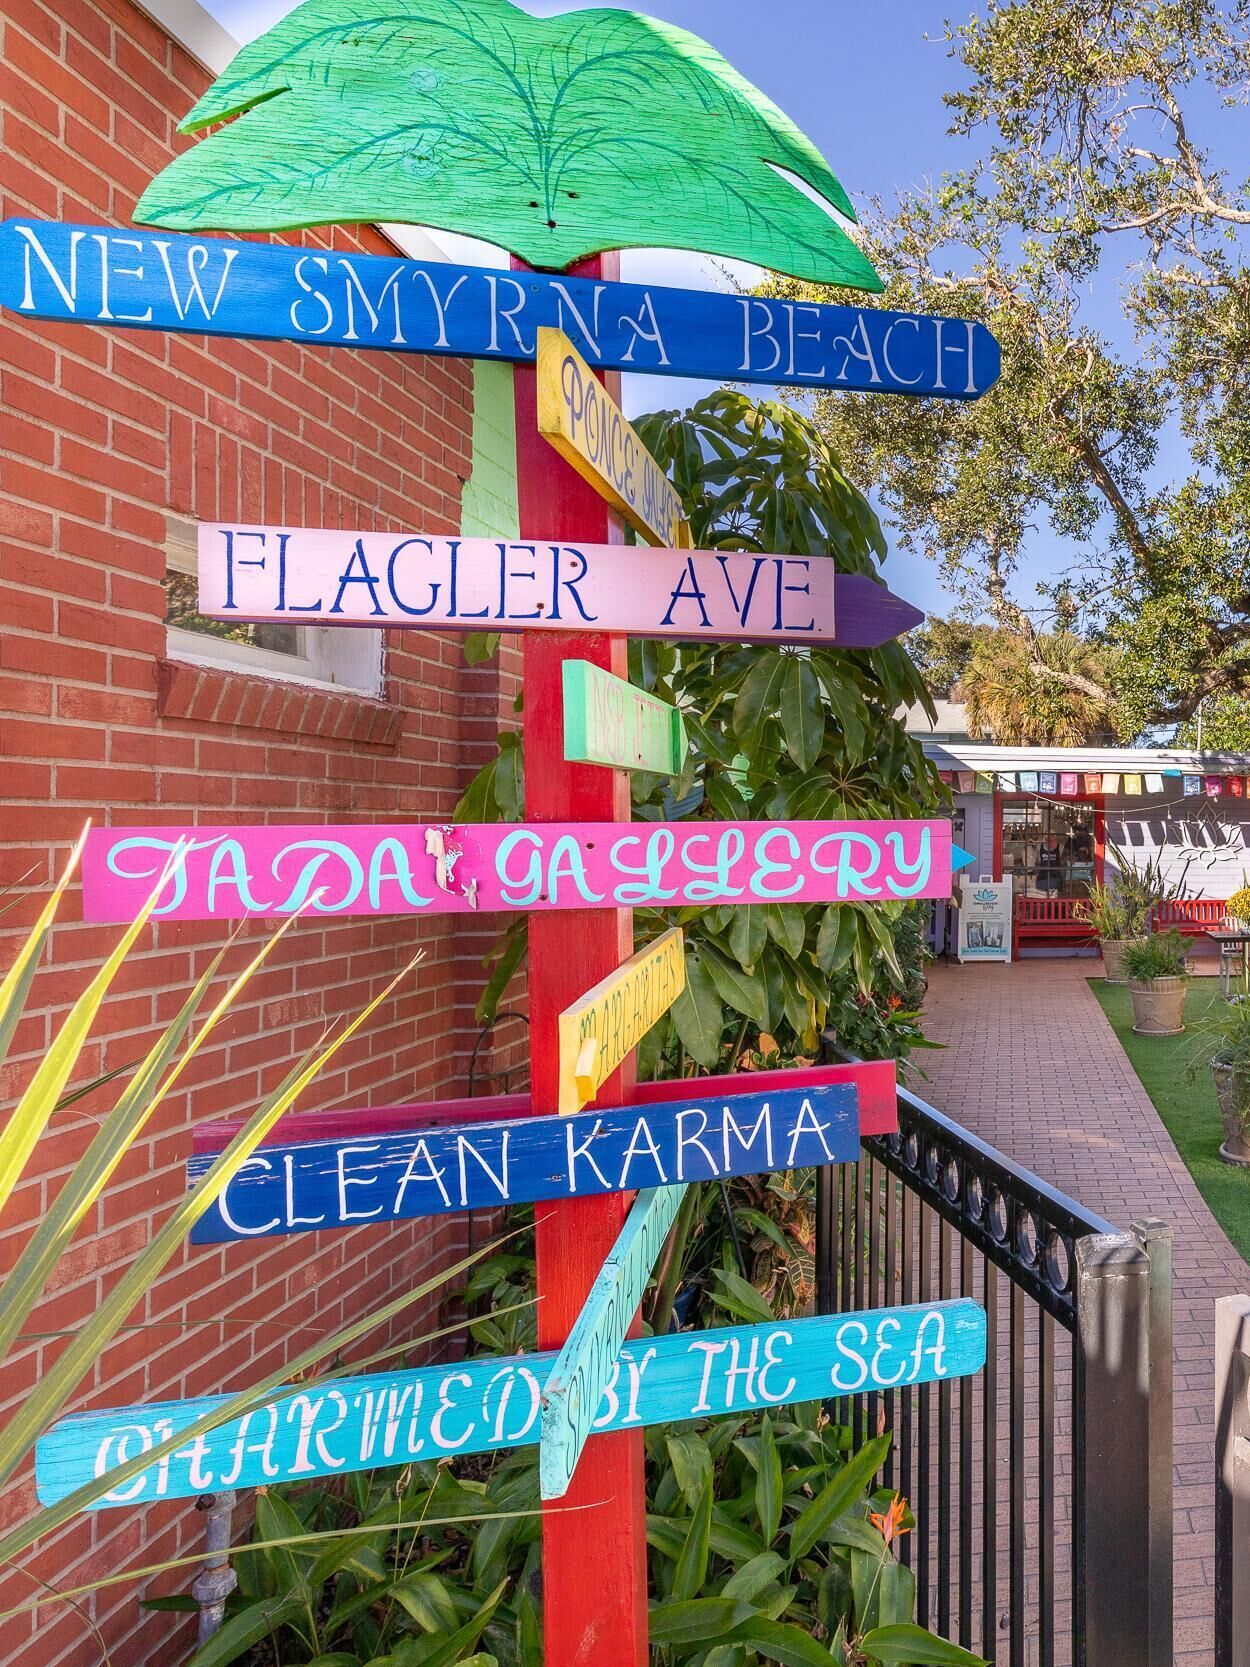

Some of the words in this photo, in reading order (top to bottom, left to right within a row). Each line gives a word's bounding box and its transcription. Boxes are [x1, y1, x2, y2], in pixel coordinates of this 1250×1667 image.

[14, 225, 240, 322] NEW
[290, 255, 673, 366] SMYRNA
[738, 299, 980, 392] BEACH
[561, 354, 636, 505] PONCE
[220, 529, 599, 622] FLAGLER
[106, 833, 435, 915] TADA
[493, 825, 932, 907] GALLERY
[214, 1127, 511, 1238] CLEAN
[564, 1098, 836, 1191] KARMA
[94, 1363, 540, 1501] CHARMED
[687, 1329, 798, 1416] THE
[830, 1311, 949, 1395] SEA
